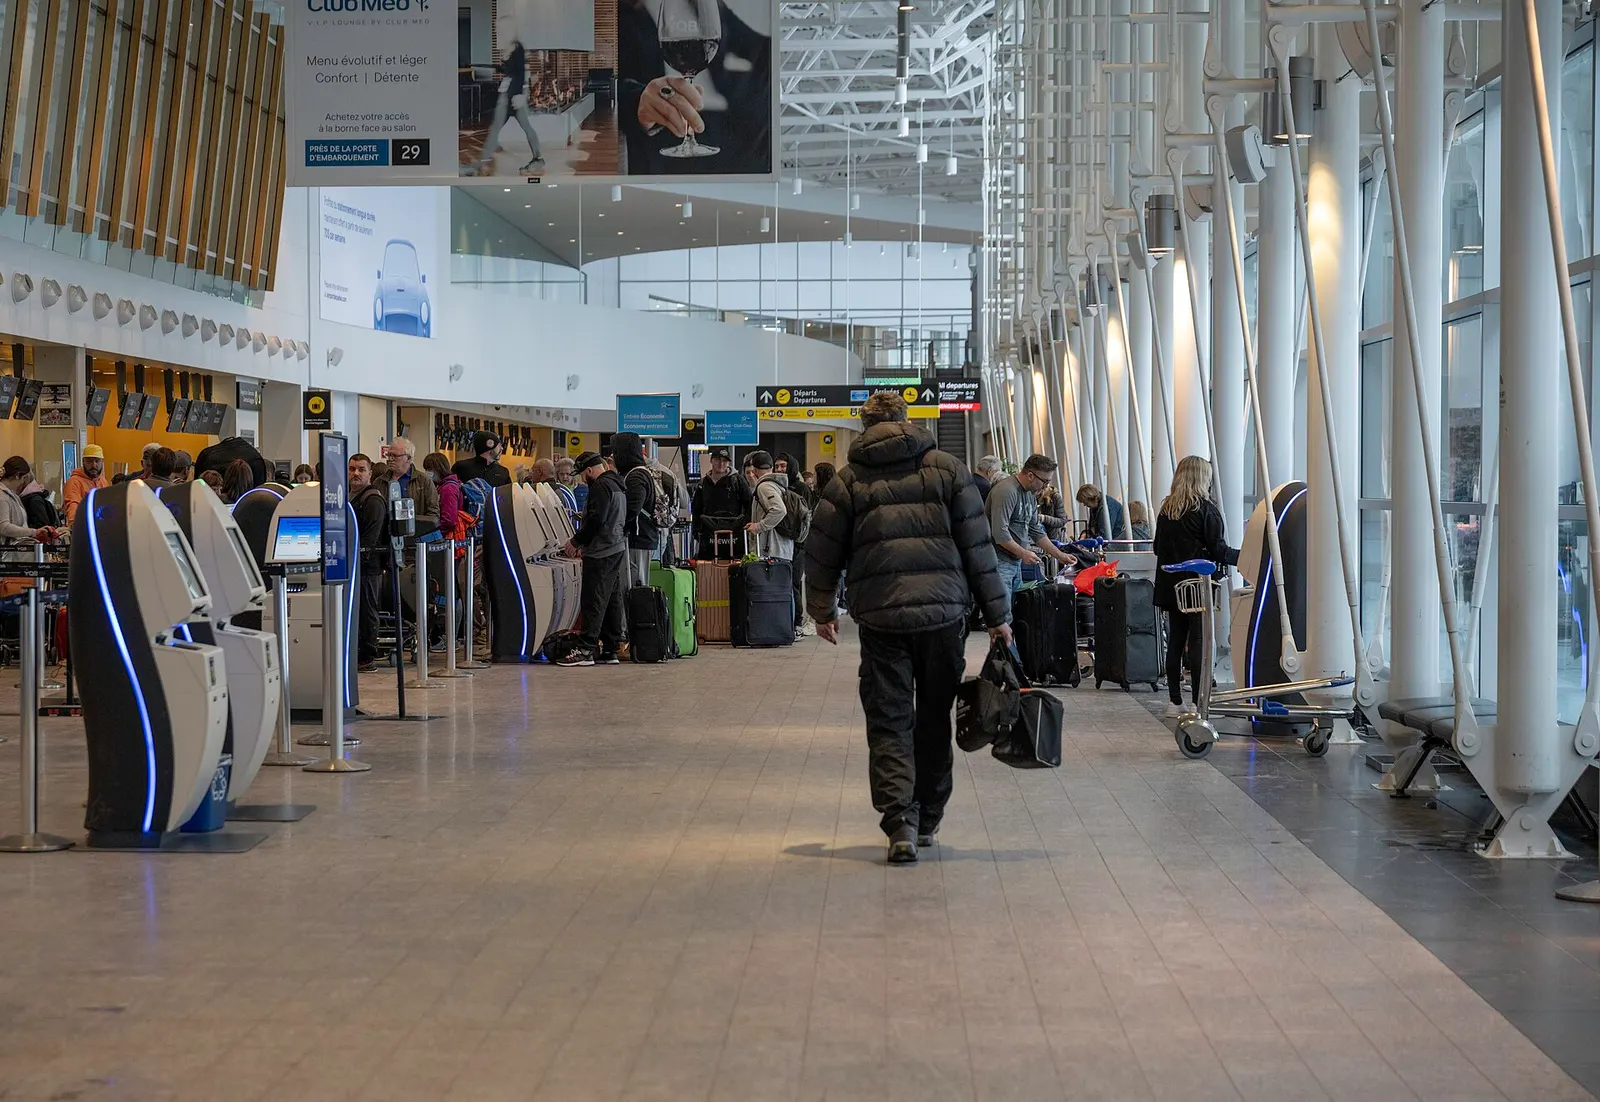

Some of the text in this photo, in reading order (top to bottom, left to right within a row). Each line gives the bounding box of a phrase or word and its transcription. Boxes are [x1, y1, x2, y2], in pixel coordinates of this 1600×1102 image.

[307, 0, 410, 12] Club Med
[306, 54, 428, 67] Menu évolutif et léger
[315, 72, 358, 83] Confort
[374, 71, 419, 83] Détente
[325, 111, 410, 121] Achetez votre accès
[325, 124, 333, 132] la
[334, 124, 360, 132] borne
[361, 124, 380, 132] face
[393, 123, 417, 132] salon
[309, 144, 329, 153] PRÈS
[401, 145, 420, 160] 29
[309, 154, 380, 162] D'EMBARQUEMENT
[946, 382, 979, 390] departures
[794, 389, 817, 398] Départs
[794, 397, 827, 405] Departures
